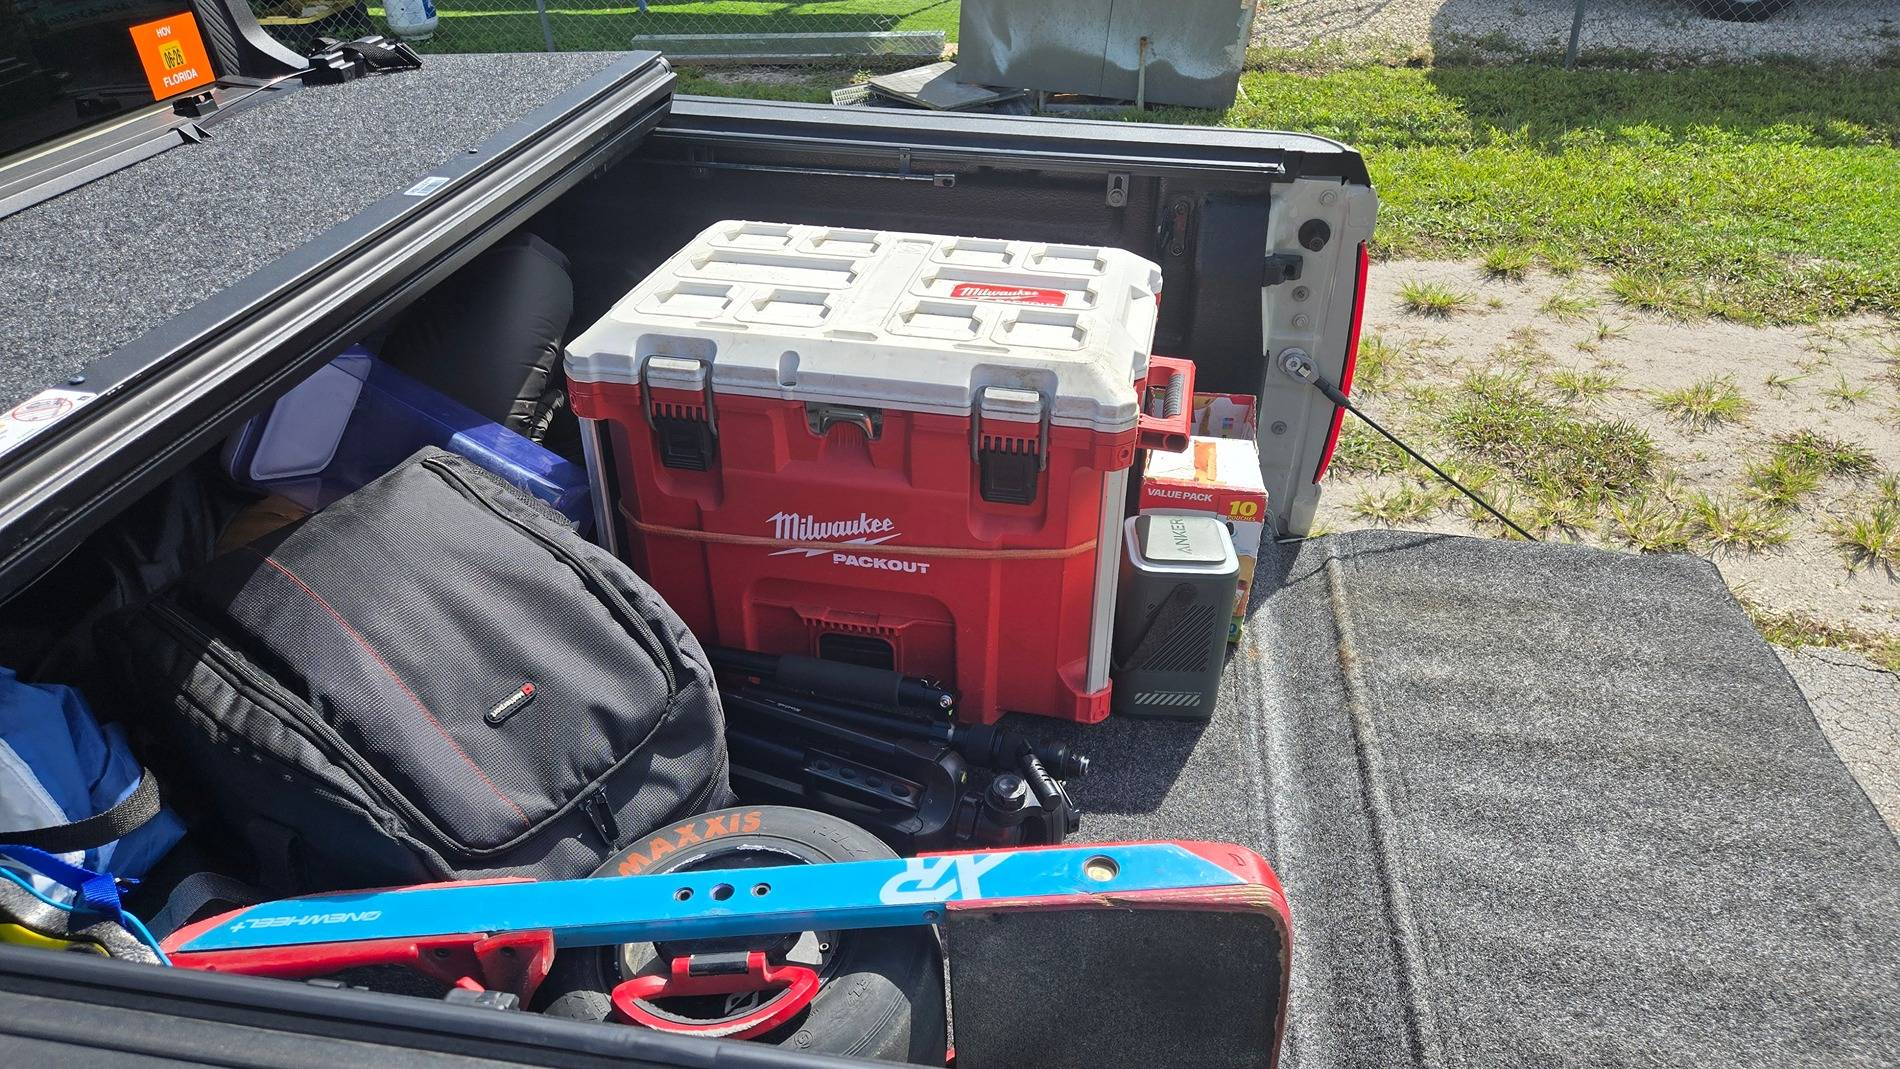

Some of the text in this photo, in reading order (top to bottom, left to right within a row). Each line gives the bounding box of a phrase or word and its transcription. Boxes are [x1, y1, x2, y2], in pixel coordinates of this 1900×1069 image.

[155, 25, 172, 38] HOV
[163, 68, 199, 88] FLORIDA
[959, 286, 1040, 297] Milwaukee
[1147, 488, 1213, 502] VALUE PACK
[1230, 500, 1258, 517] 10
[765, 511, 896, 541] Milwaukee
[1169, 516, 1193, 555] ANKER
[833, 553, 931, 574] PACKOUT
[617, 811, 763, 877] MAXXIS
[879, 853, 1017, 906] XR
